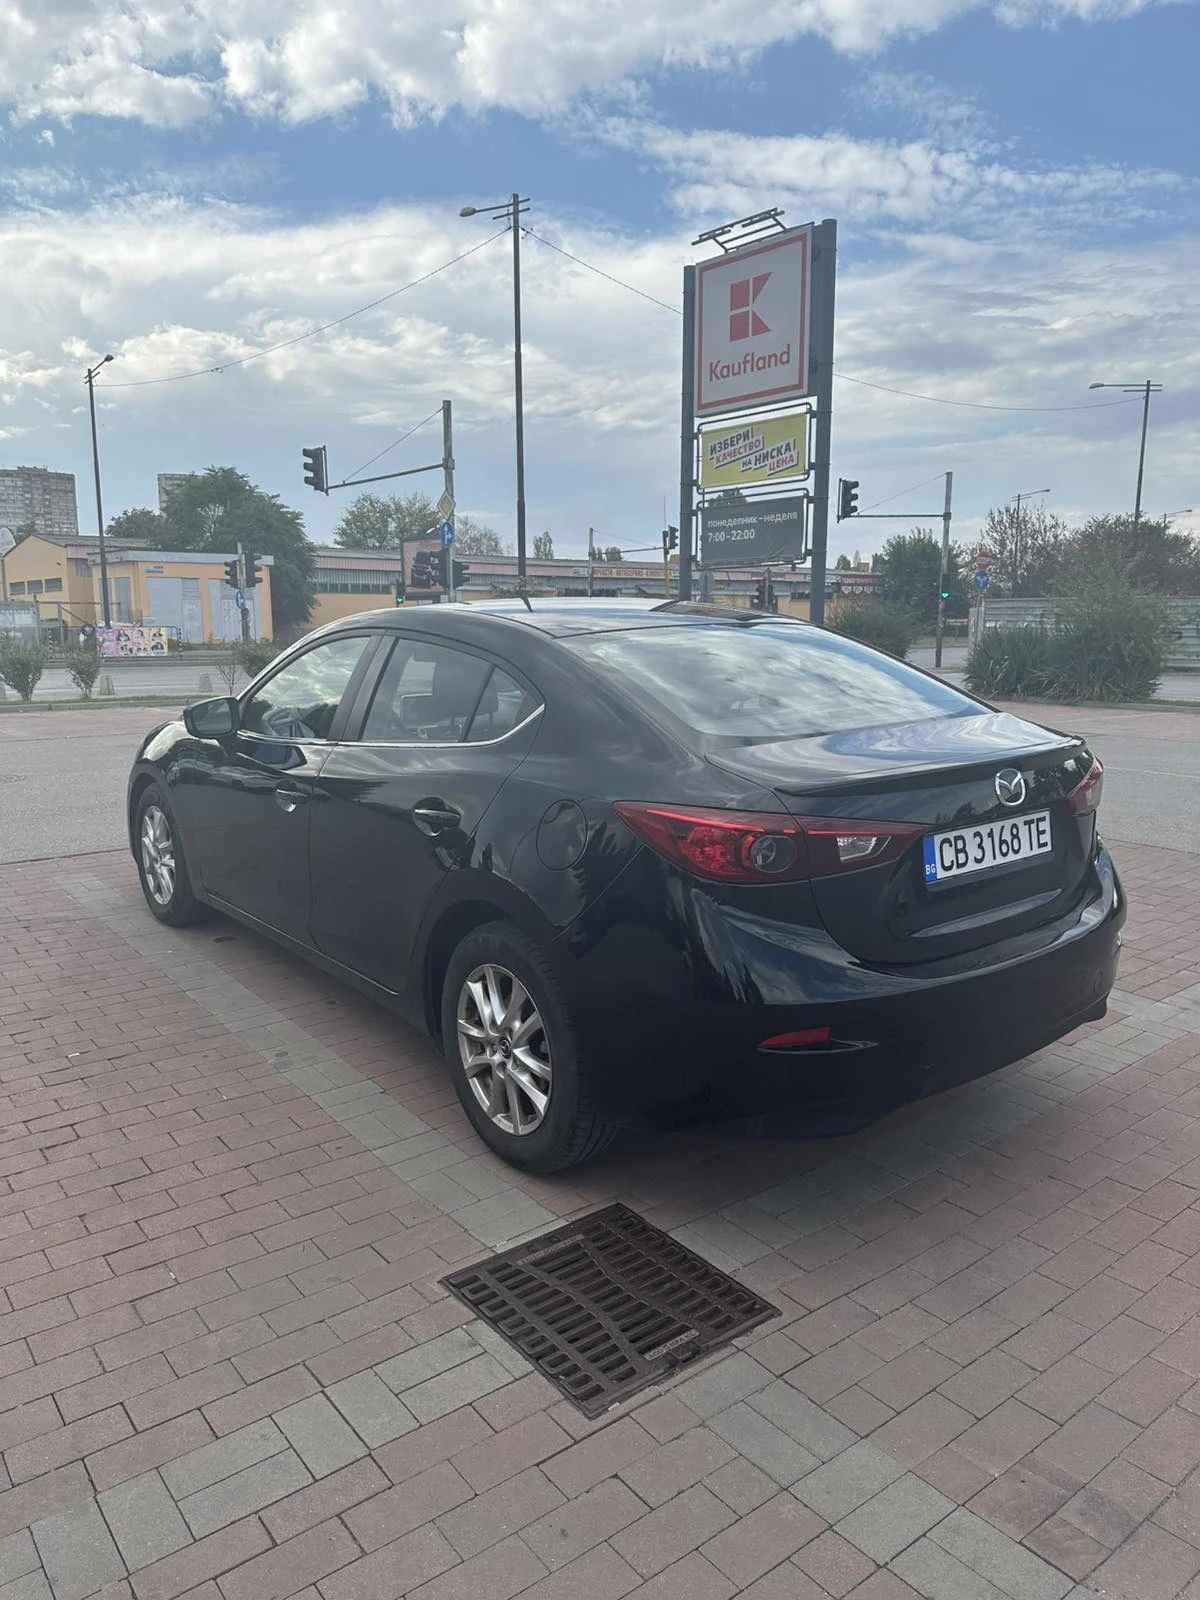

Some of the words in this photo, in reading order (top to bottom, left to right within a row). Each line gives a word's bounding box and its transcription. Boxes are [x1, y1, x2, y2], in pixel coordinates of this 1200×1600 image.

[708, 344, 791, 382] Kaufland
[710, 429, 750, 456] ИЗБЕРИ
[715, 438, 761, 466] КАЧЕСТВО
[742, 457, 752, 468] НА
[754, 441, 792, 466] НИСКА
[768, 453, 795, 472] ЦЕНА
[925, 863, 936, 875] BG
